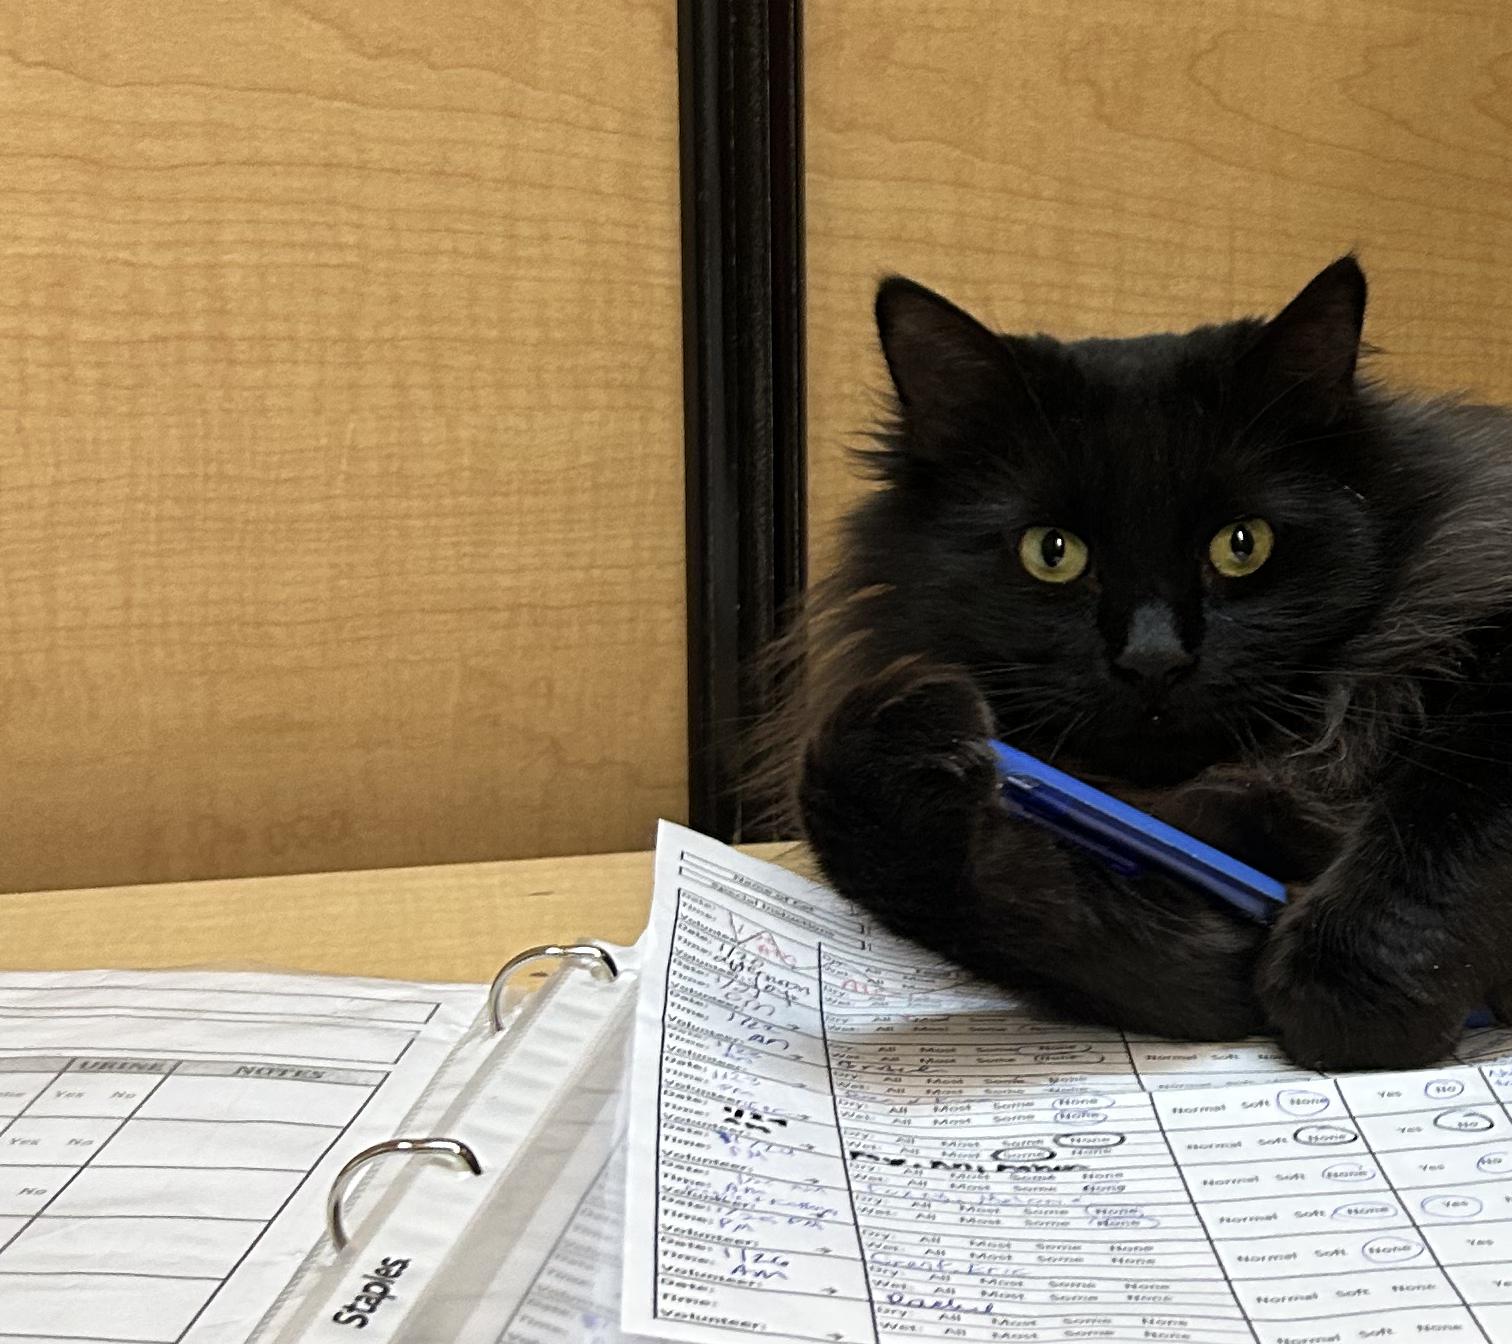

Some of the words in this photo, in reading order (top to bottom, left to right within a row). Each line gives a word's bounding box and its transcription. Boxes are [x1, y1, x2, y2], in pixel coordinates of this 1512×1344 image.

[80, 1061, 165, 1072] URINE
[234, 1066, 325, 1079] NOTES
[55, 1090, 85, 1098] Yes
[109, 1090, 137, 1099] No
[1377, 1090, 1402, 1098] Yes
[1172, 1104, 1225, 1114] Normal
[1241, 1099, 1270, 1109] Soft
[1289, 1097, 1327, 1106] None
[1398, 1126, 1423, 1134] Yes
[1457, 1121, 1479, 1129] No
[9, 1137, 41, 1146] Yes
[66, 1137, 93, 1146] No
[1187, 1141, 1242, 1150] Normal
[1258, 1137, 1288, 1146] Soft
[1308, 1133, 1346, 1141] None
[1419, 1163, 1445, 1171] Yes
[1202, 1175, 1259, 1186] Normal
[1275, 1173, 1305, 1181] Soft
[1326, 1170, 1367, 1179] None
[17, 1187, 47, 1196] No
[1443, 1200, 1469, 1208] Yes
[1219, 1213, 1278, 1223] Normal
[1294, 1210, 1326, 1219] Soft
[1347, 1206, 1390, 1215] None
[1466, 1239, 1494, 1247] Yes
[1236, 1251, 1297, 1263] Normal
[1314, 1248, 1348, 1258] Soft
[1368, 1244, 1412, 1254] None
[332, 1257, 412, 1329] Staples
[1256, 1292, 1318, 1304] Normal
[1336, 1288, 1371, 1297] Soft
[1391, 1283, 1437, 1292] None
[1276, 1334, 1341, 1344] Normal
[1358, 1328, 1393, 1338] Soft
[1416, 1323, 1463, 1332] None
